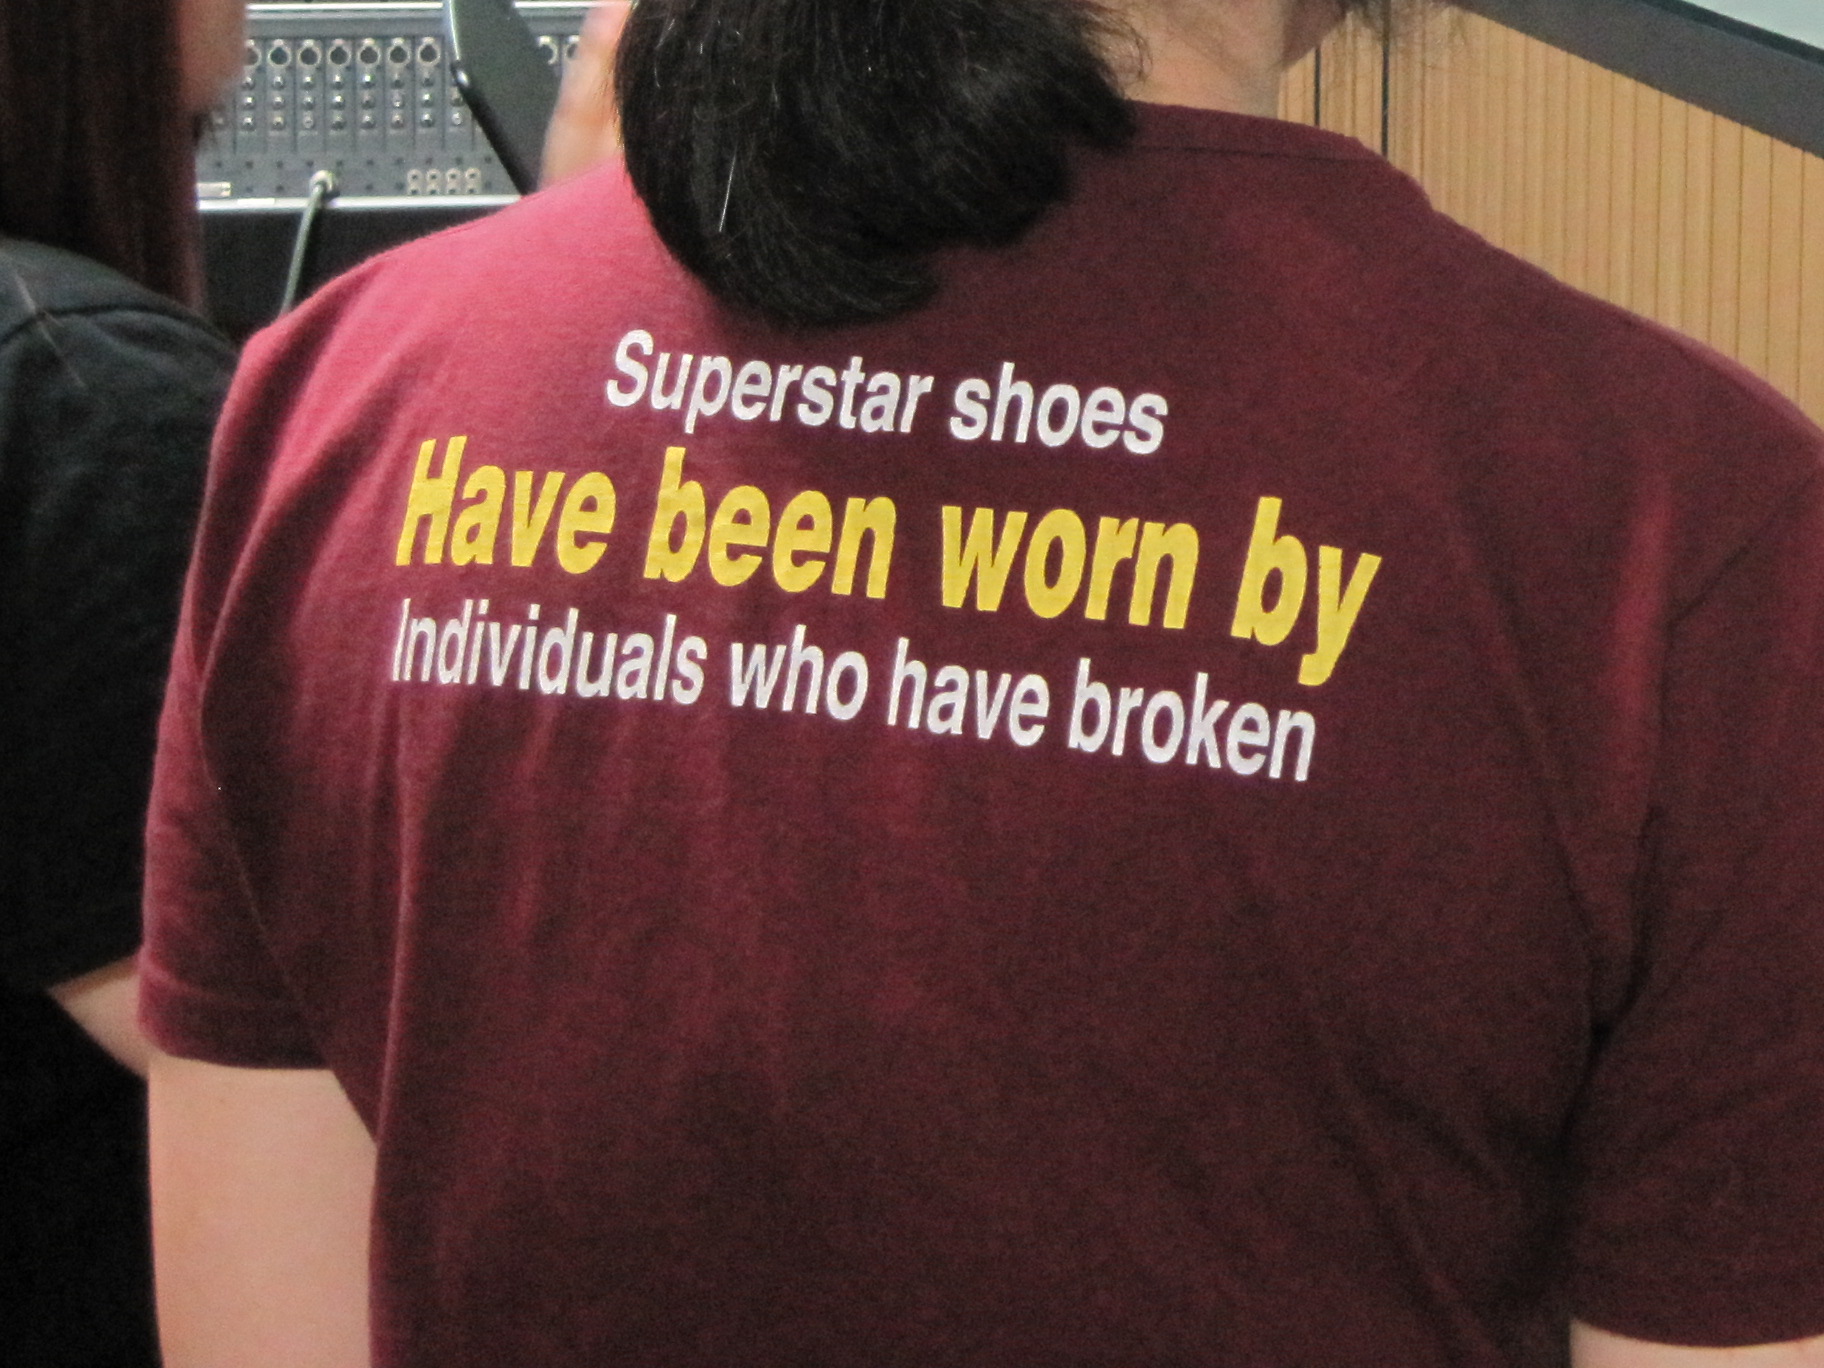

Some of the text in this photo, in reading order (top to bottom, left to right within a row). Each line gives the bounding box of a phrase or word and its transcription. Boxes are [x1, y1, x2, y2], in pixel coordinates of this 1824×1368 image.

[607, 329, 1169, 455] Superstar shoes
[396, 435, 1382, 686] Have been worn by
[392, 597, 1316, 782] Individuals who have broken
